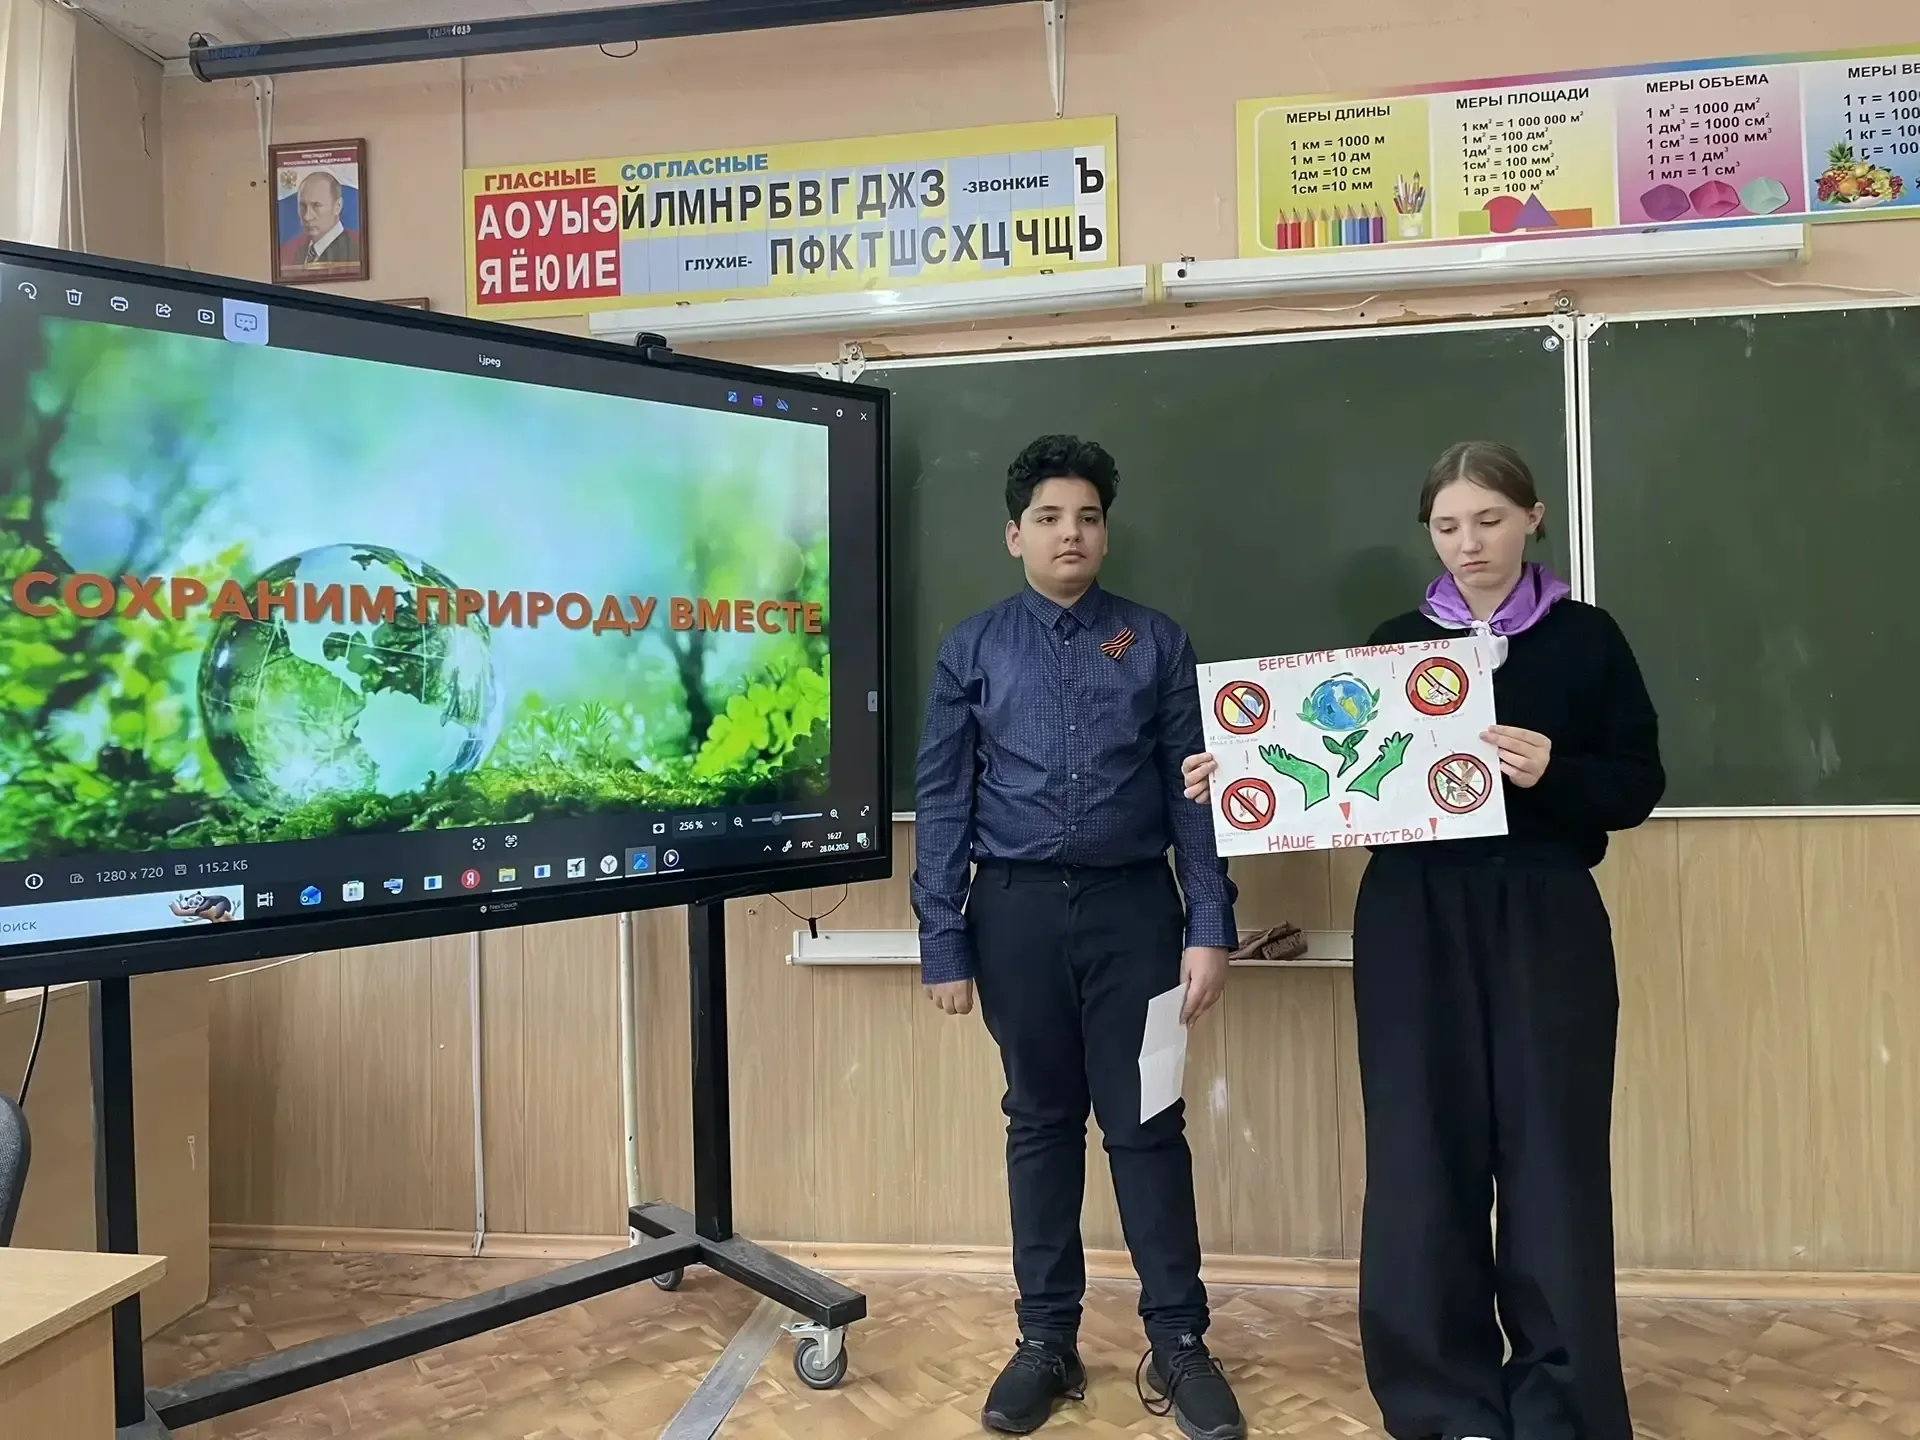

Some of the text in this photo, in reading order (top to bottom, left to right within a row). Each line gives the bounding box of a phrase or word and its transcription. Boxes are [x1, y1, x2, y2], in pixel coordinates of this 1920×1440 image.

[1848, 64, 1896, 79] МЕРЫ
[1646, 73, 1769, 93] МЕРЫ ОБЪЕМА
[1456, 87, 1589, 109] МЕРЫ ПЛОЩАДИ
[1843, 94, 1851, 106] 1
[1857, 96, 1867, 105] т
[1888, 89, 1920, 103] 100
[1286, 105, 1390, 124] МЕРЫ ДЛИНЫ
[1646, 107, 1652, 119] 1
[1694, 102, 1729, 114] 1000
[1844, 111, 1851, 123] 1
[1859, 113, 1870, 124] ц
[1462, 122, 1467, 131] 1
[1508, 118, 1513, 128] 1
[1518, 116, 1540, 127] 000
[1544, 114, 1566, 124] 000
[1646, 123, 1652, 134] 1
[1705, 117, 1739, 129] 1000
[1462, 135, 1468, 144] 1
[1501, 131, 1523, 141] 100
[1845, 128, 1852, 140] 1
[1860, 130, 1876, 140] кг
[1897, 124, 1920, 137] 10
[1291, 140, 1297, 151] 1
[1302, 141, 1320, 150] км
[1337, 135, 1370, 147] 1000
[1374, 136, 1385, 144] м
[1507, 143, 1528, 154] 100
[1647, 139, 1653, 149] 1
[1704, 132, 1739, 145] 1000
[1291, 155, 1297, 165] 1
[1302, 156, 1313, 165] м
[1331, 151, 1346, 162] 10
[1350, 152, 1371, 163] дм
[1647, 154, 1653, 165] 1
[1660, 155, 1670, 164] л
[1689, 151, 1695, 162] 1
[1846, 146, 1853, 158] 1
[620, 153, 768, 182] СОГЛАСНЫЕ
[1506, 156, 1527, 167] 100
[484, 167, 596, 191] ГЛАСНЫЕ
[1352, 166, 1371, 176] см
[1463, 174, 1468, 183] 1
[1502, 170, 1516, 180] 10
[1520, 168, 1541, 178] 000
[1648, 169, 1654, 180] 1
[1661, 170, 1682, 180] мл
[1702, 165, 1708, 176] 1
[1351, 181, 1373, 190] мм
[1463, 187, 1469, 196] 1
[1474, 187, 1489, 197] ар
[1505, 182, 1526, 193] 100
[12, 571, 823, 636] СОХРАНИМ ПРИРОДУ ВМЕСТЕ
[1258, 650, 1336, 671] БЕРЕГИТЕ
[1421, 640, 1450, 651] ЭТО
[679, 821, 694, 831] 256
[827, 832, 842, 840] 16:27
[1268, 835, 1316, 851] НАШЕ
[801, 840, 814, 849] РУС
[198, 858, 249, 875] 115.2 КБ
[96, 870, 126, 883] 1280
[140, 867, 164, 879] 720
